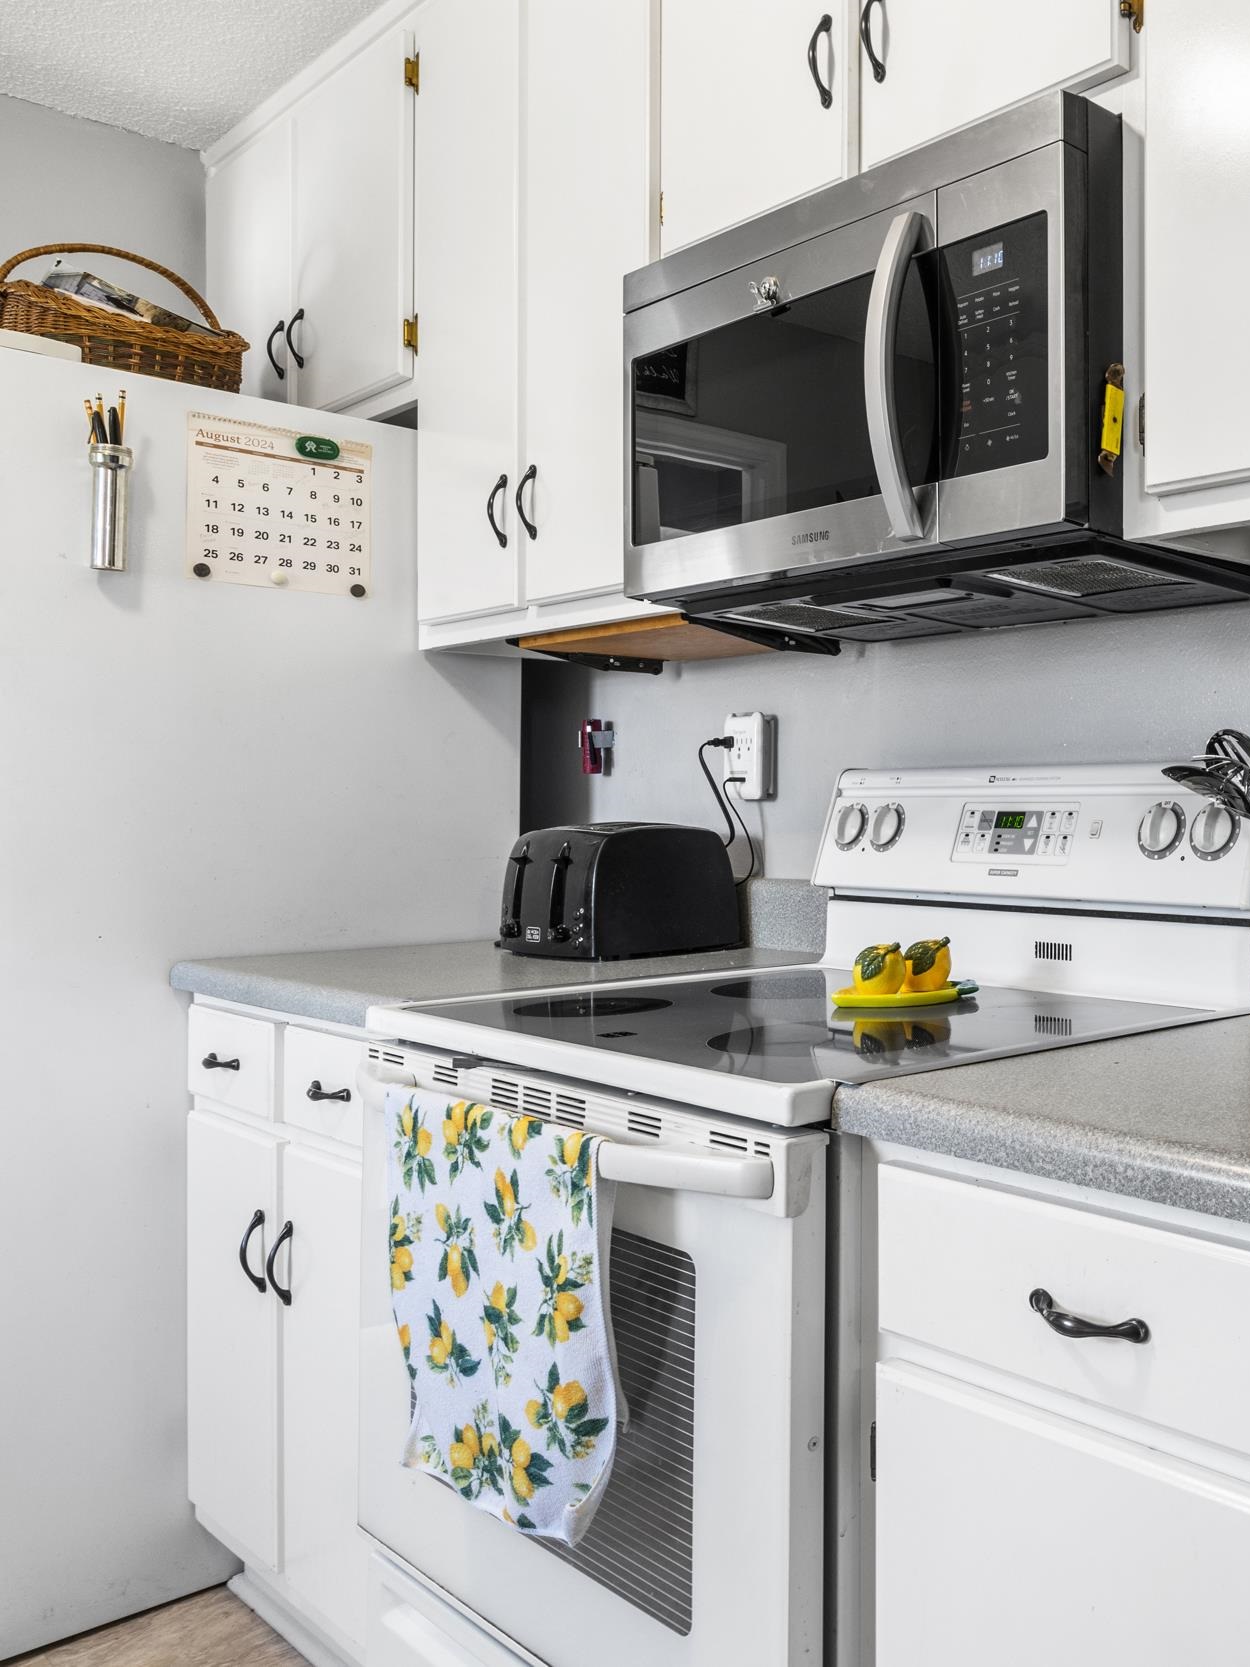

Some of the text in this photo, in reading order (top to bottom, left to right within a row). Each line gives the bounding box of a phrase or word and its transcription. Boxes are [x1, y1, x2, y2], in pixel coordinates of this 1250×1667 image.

[196, 428, 275, 450] August 2024
[310, 467, 363, 484] 1 2 3
[211, 475, 363, 507] 4 5 6 7 8 9 10
[205, 498, 363, 530] 11 12 13 14 15 16 17
[204, 523, 362, 553] 18 19 20 21 22 23 24
[791, 530, 830, 546] SAMSUNG
[203, 548, 361, 577] 25 26 27 28 29 30 31
